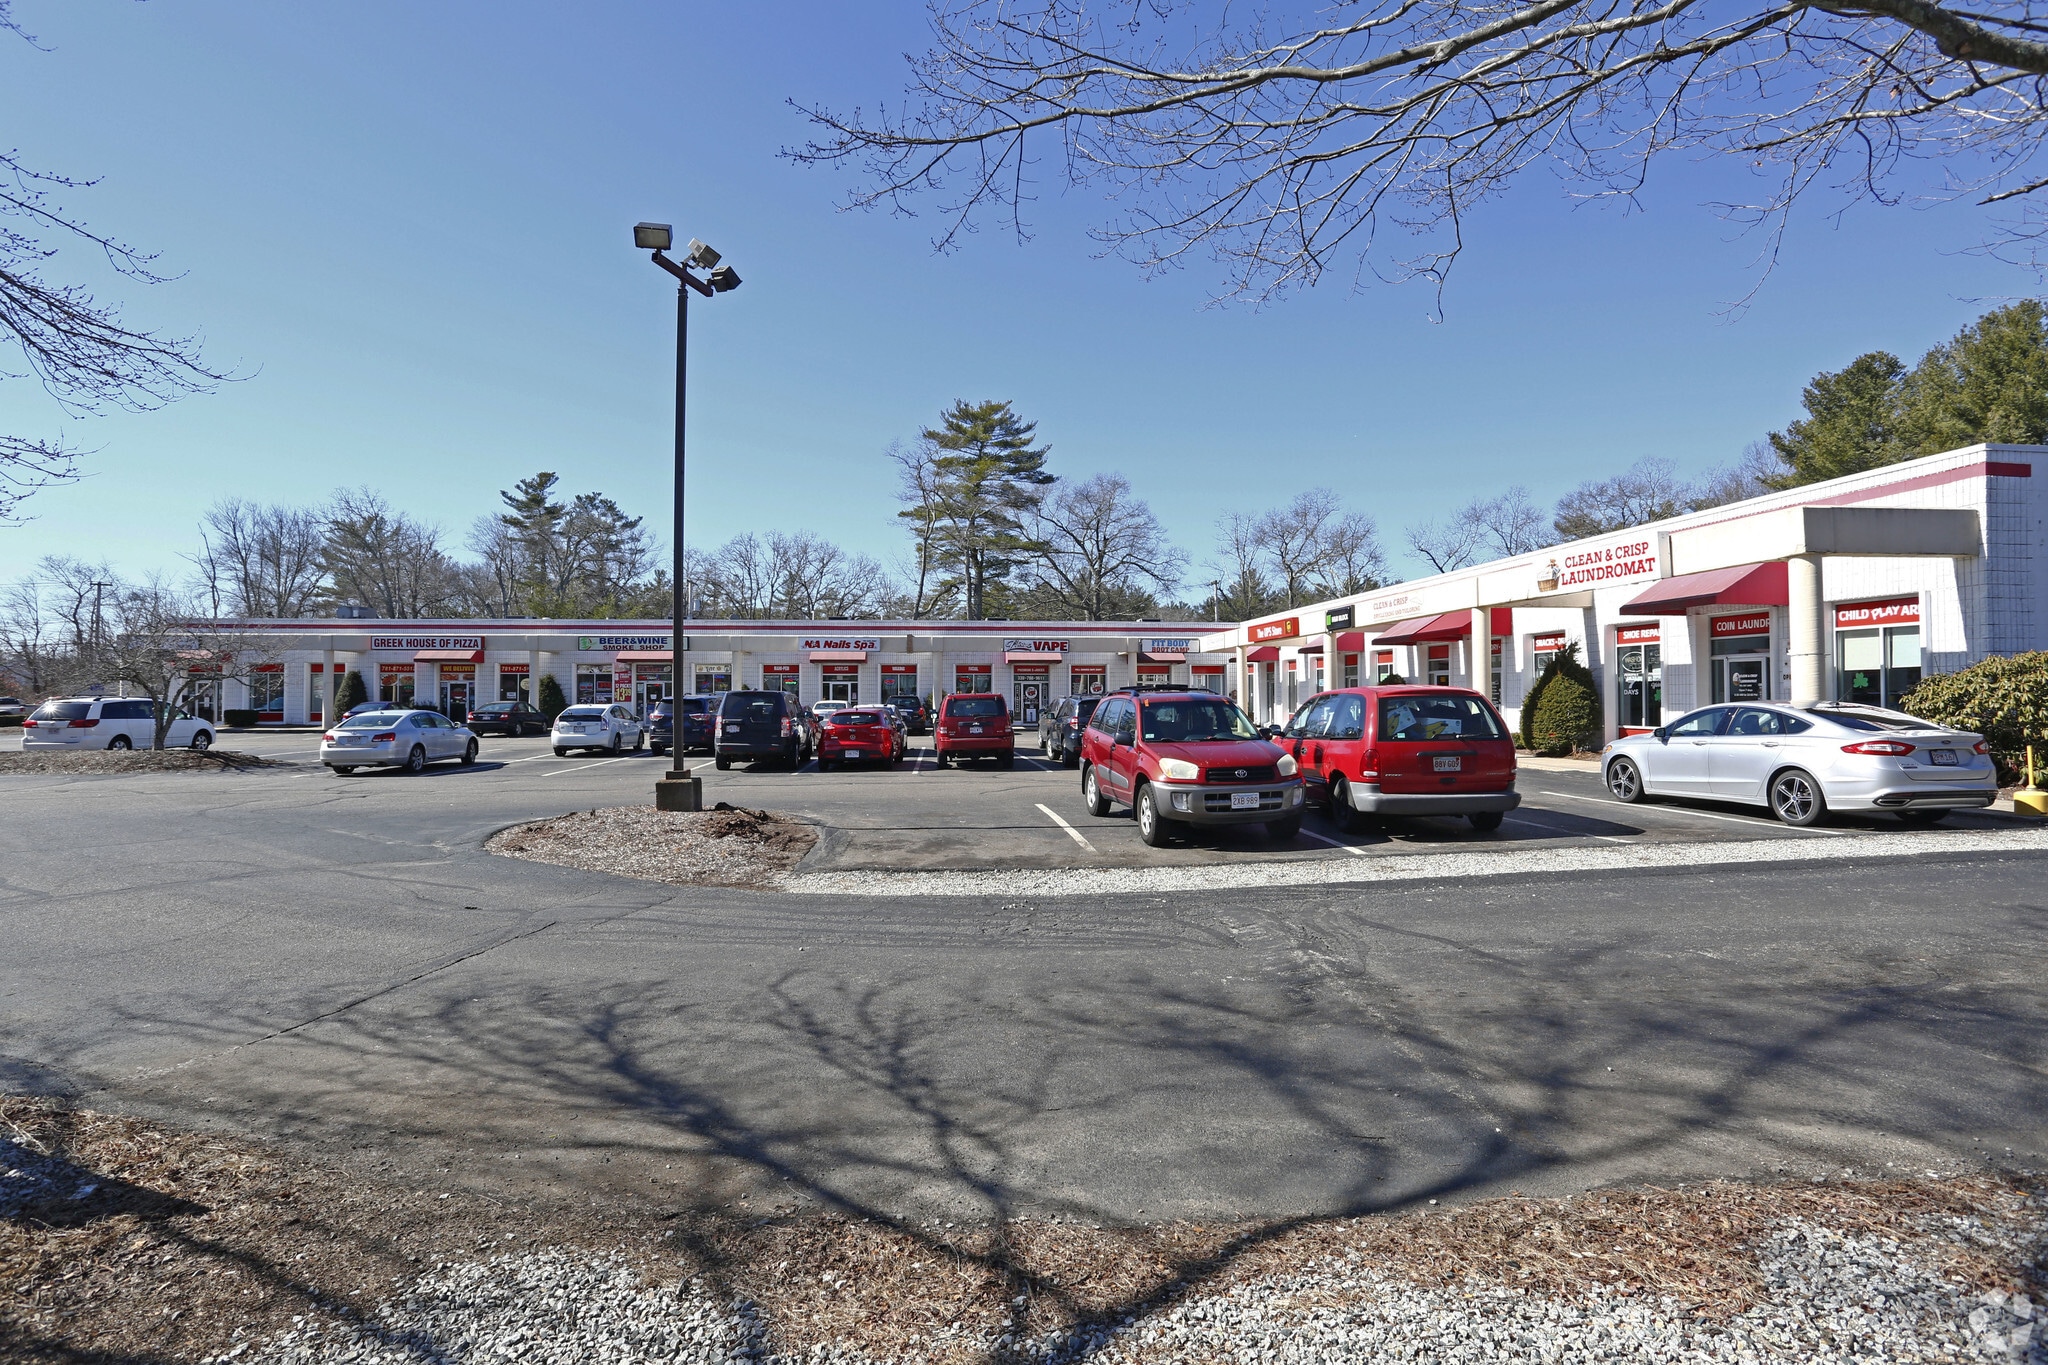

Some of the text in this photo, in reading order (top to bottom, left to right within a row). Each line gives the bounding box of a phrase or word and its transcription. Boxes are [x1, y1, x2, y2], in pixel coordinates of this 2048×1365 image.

[1564, 542, 1649, 568] CLEAN & CRISP
[1561, 557, 1656, 586] LAUNDROMAT
[1373, 602, 1388, 610] CLEAN
[1393, 596, 1408, 606] CRISP
[1838, 608, 1870, 621] CHILD
[1871, 604, 1900, 620] PLAY
[1339, 614, 1348, 622] BLOCK
[1272, 626, 1282, 636] Store
[1716, 621, 1735, 631] COIN
[1623, 630, 1640, 639] SHOE
[374, 638, 479, 648] GREEK HOUSE OF PIZZA
[823, 640, 851, 648] Nails
[853, 640, 875, 650] Spa
[1033, 641, 1068, 651] VAPE
[1536, 638, 1555, 647] SNACKS
[1628, 680, 1635, 688] 7
[1233, 797, 1245, 805] 2XB
